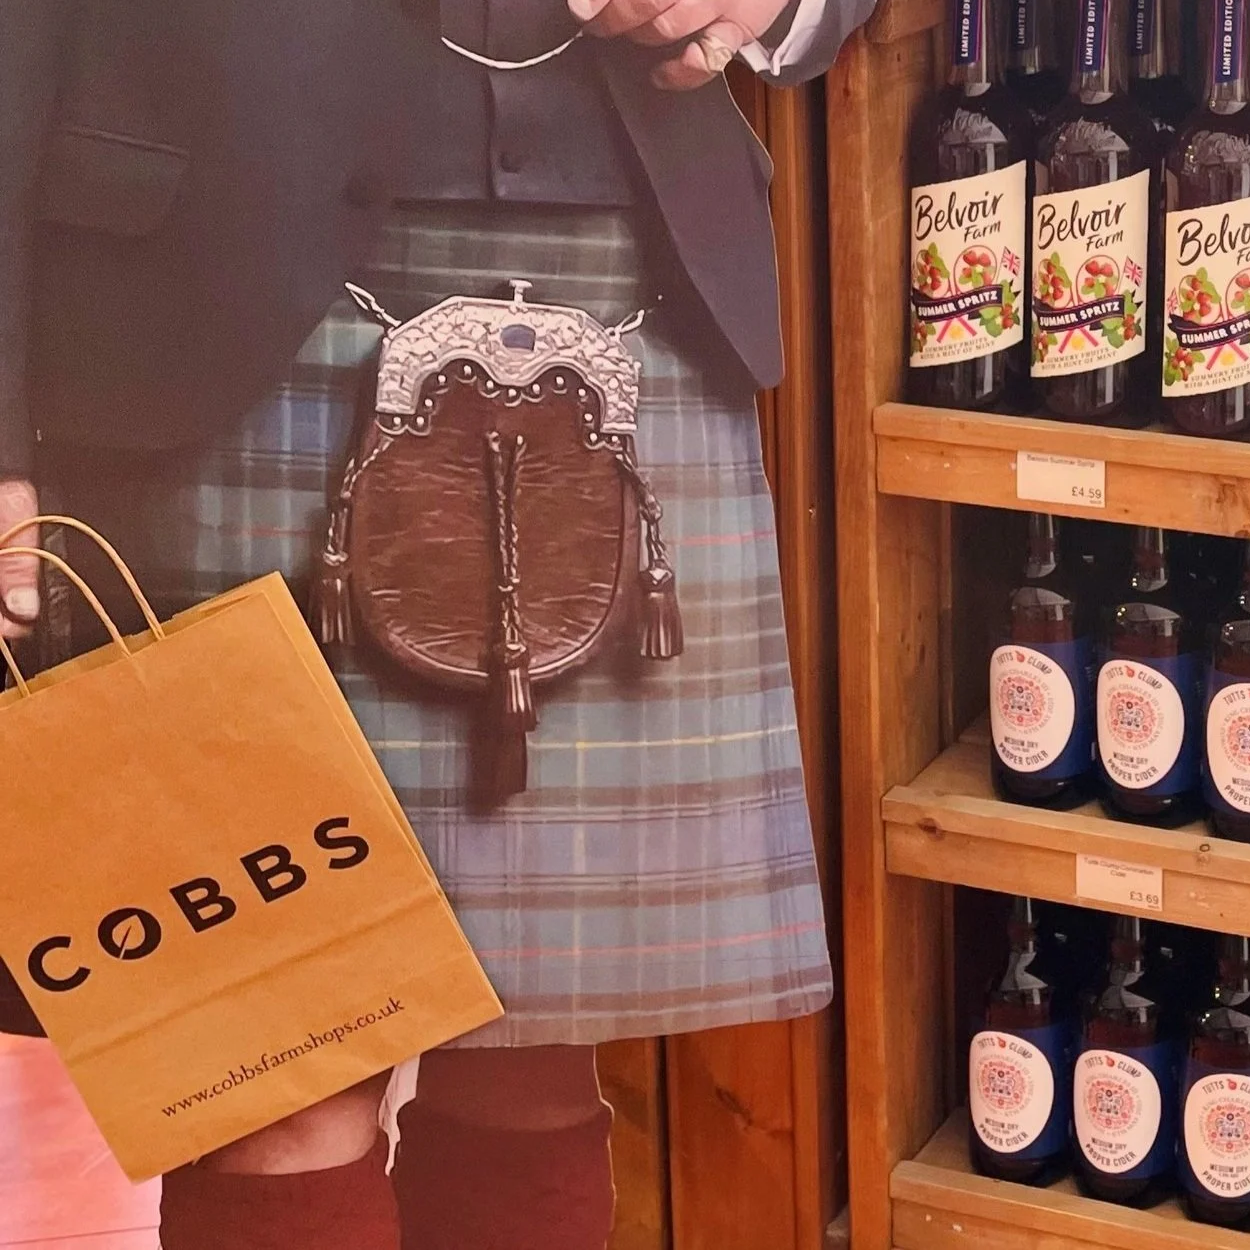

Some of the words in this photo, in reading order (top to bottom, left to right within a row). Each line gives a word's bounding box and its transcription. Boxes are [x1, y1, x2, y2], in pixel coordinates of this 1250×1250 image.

[915, 191, 1004, 241] Belvoir
[1037, 200, 1127, 251] Belvoir
[964, 220, 1001, 243] Farm
[1086, 230, 1124, 252] Farm
[958, 290, 999, 308] SPRITZ
[1080, 300, 1120, 320] SPRITZ
[1135, 765, 1159, 782] CIDER
[28, 816, 370, 992] COBBS
[161, 995, 405, 1119] www.cobbsfarmshops.co.uk
